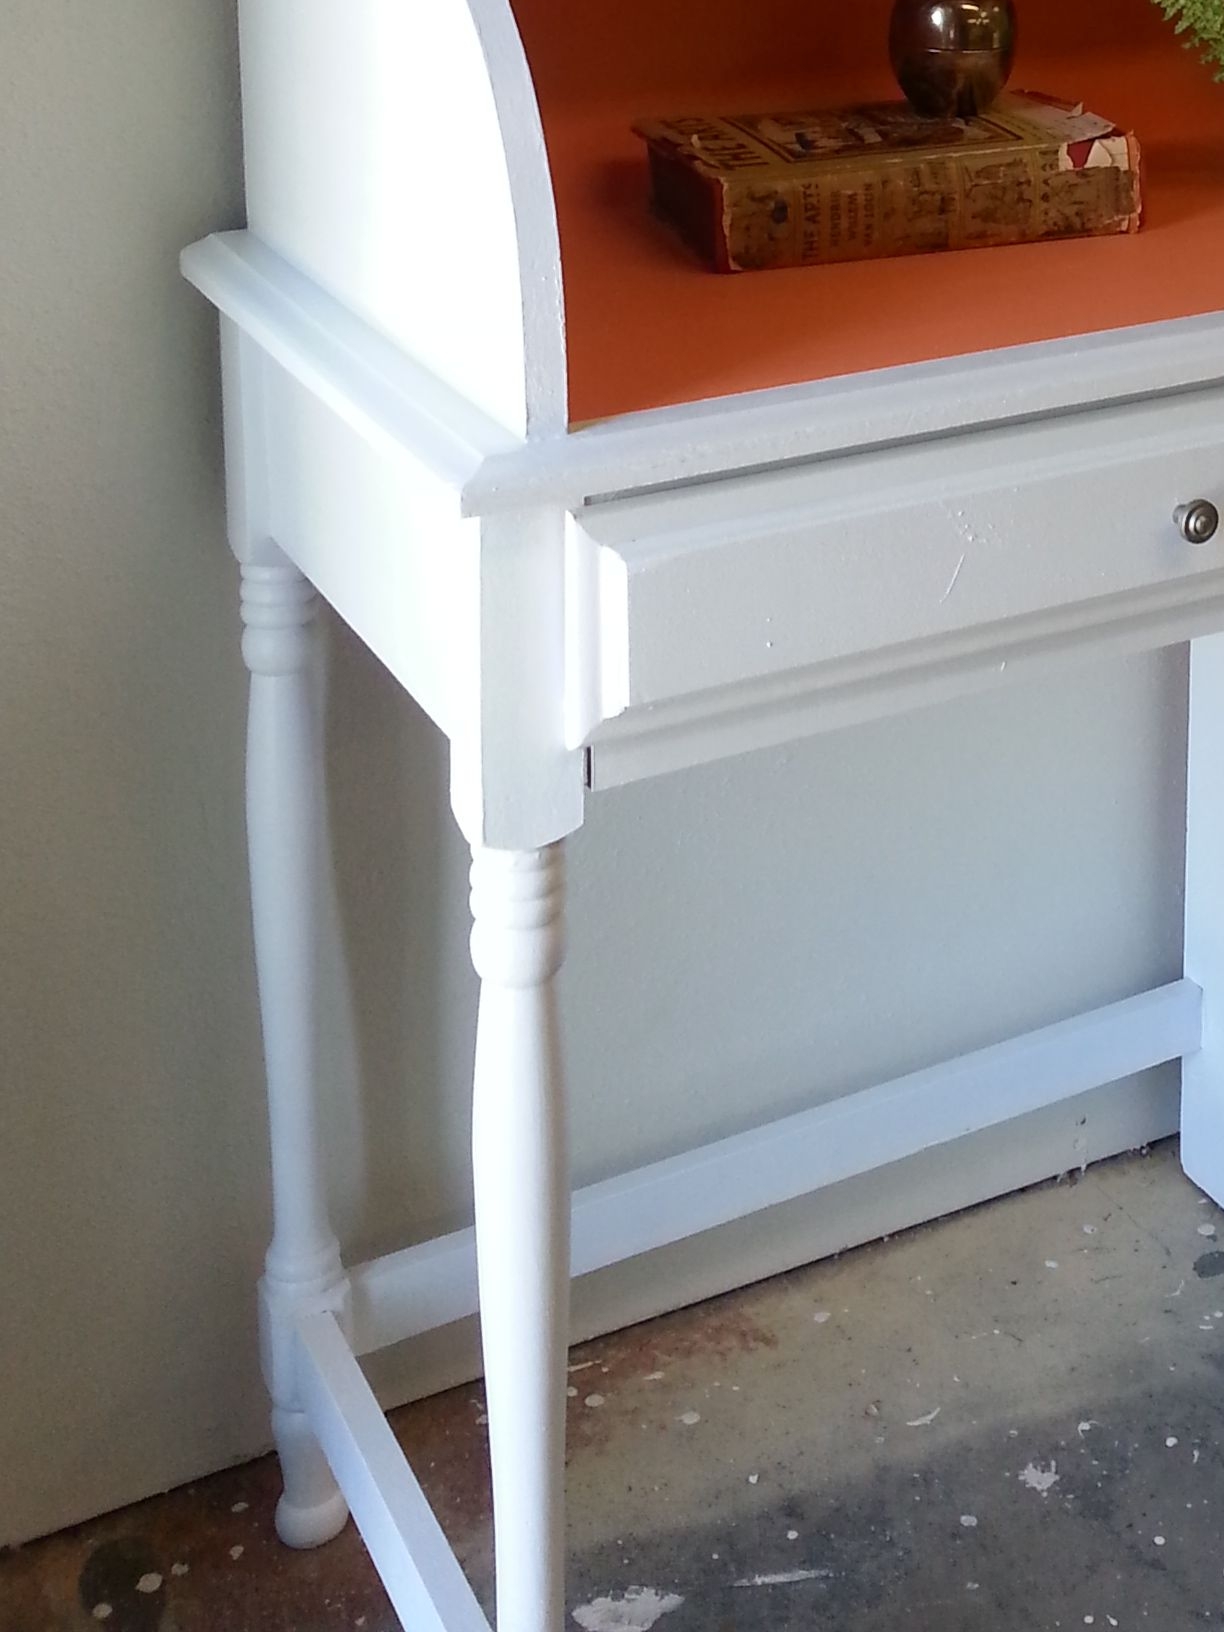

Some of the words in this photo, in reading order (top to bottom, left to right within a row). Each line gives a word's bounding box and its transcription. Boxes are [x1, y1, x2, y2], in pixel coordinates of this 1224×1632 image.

[702, 143, 770, 170] THE
[801, 182, 821, 225] ARTS
[863, 182, 875, 218] LOON
[801, 231, 820, 260] THE
[863, 223, 874, 247] VAN
